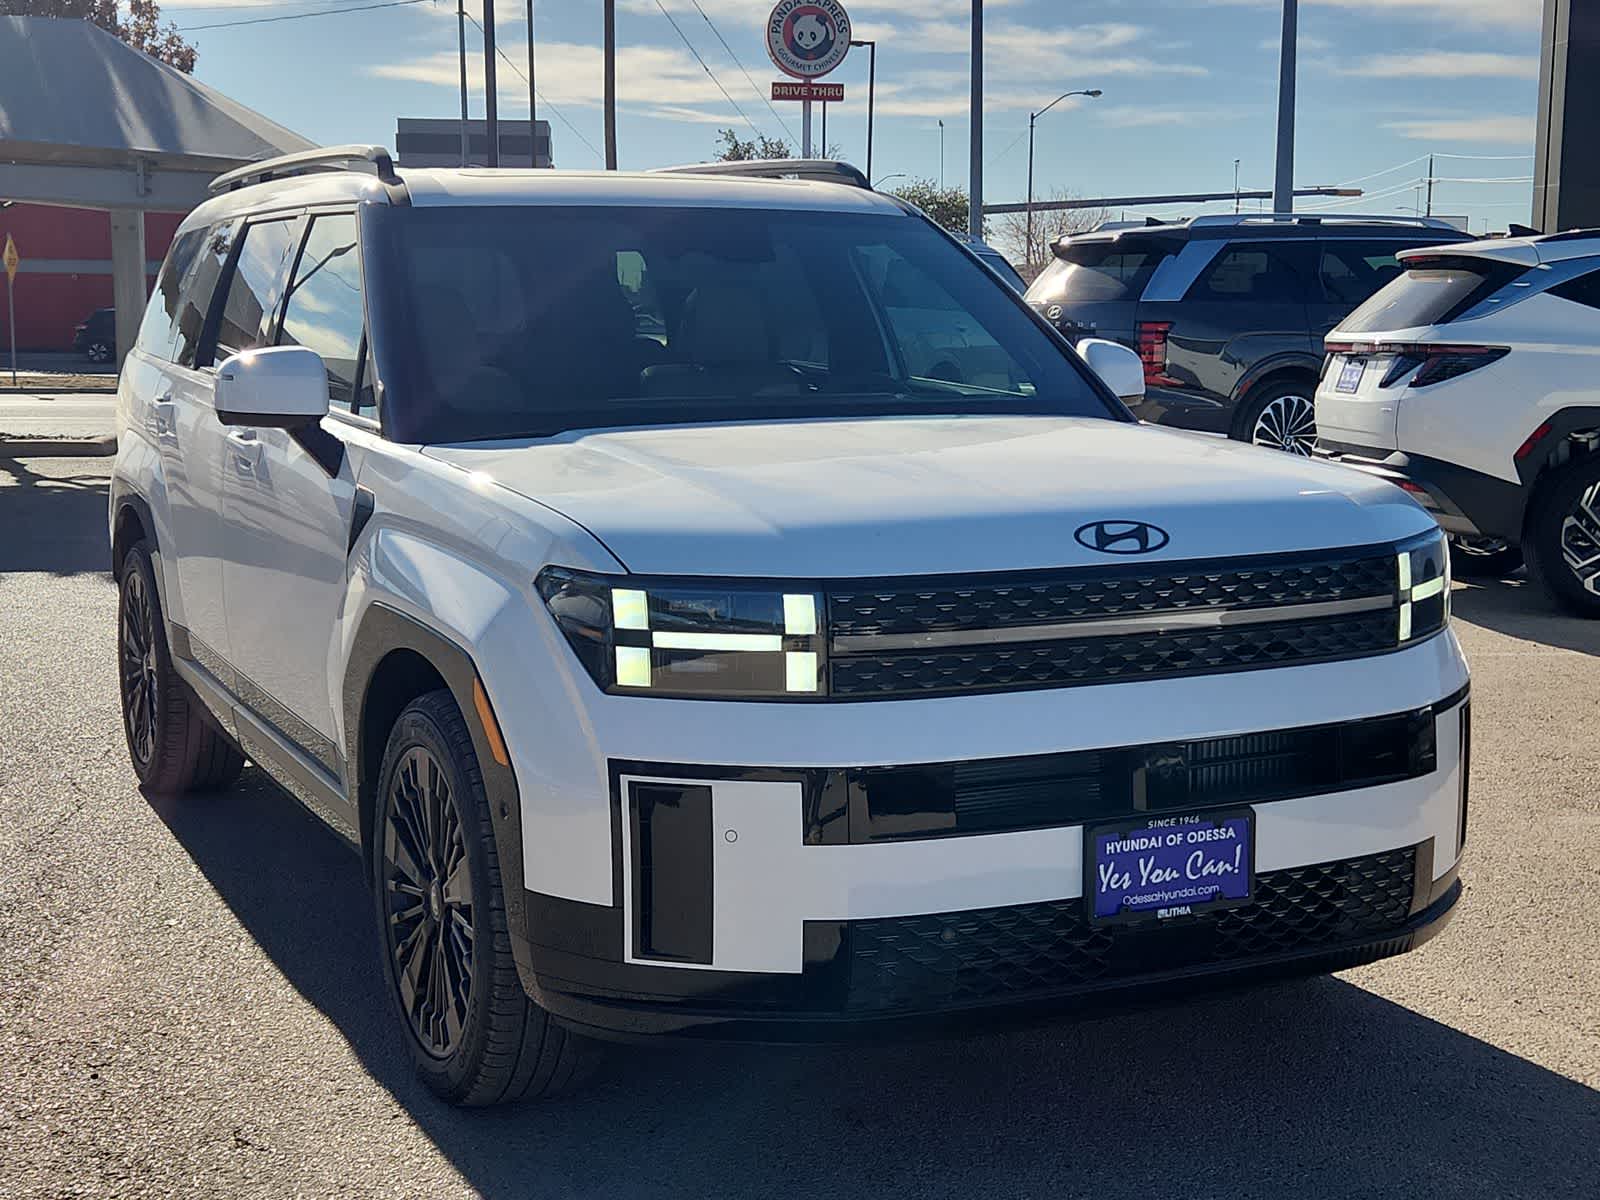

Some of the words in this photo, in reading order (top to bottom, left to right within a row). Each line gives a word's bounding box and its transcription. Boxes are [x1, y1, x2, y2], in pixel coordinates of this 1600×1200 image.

[771, 0, 802, 34] PANDA
[778, 48, 811, 71] GOURMET
[813, 49, 841, 71] CHINESE
[773, 86, 808, 96] DRIVE
[811, 87, 843, 97] THRU
[1147, 817, 1177, 829] SINCE
[1179, 815, 1200, 825] 1946
[1106, 838, 1162, 855] HYUNDAI
[1166, 833, 1183, 846] OF
[1187, 827, 1236, 843] ODESSA
[1099, 861, 1132, 893] Yes
[1138, 855, 1180, 886] You
[1185, 843, 1242, 880] Can!
[1122, 885, 1219, 905] OdessaHyundai.com
[1164, 905, 1192, 918] LITHIA
